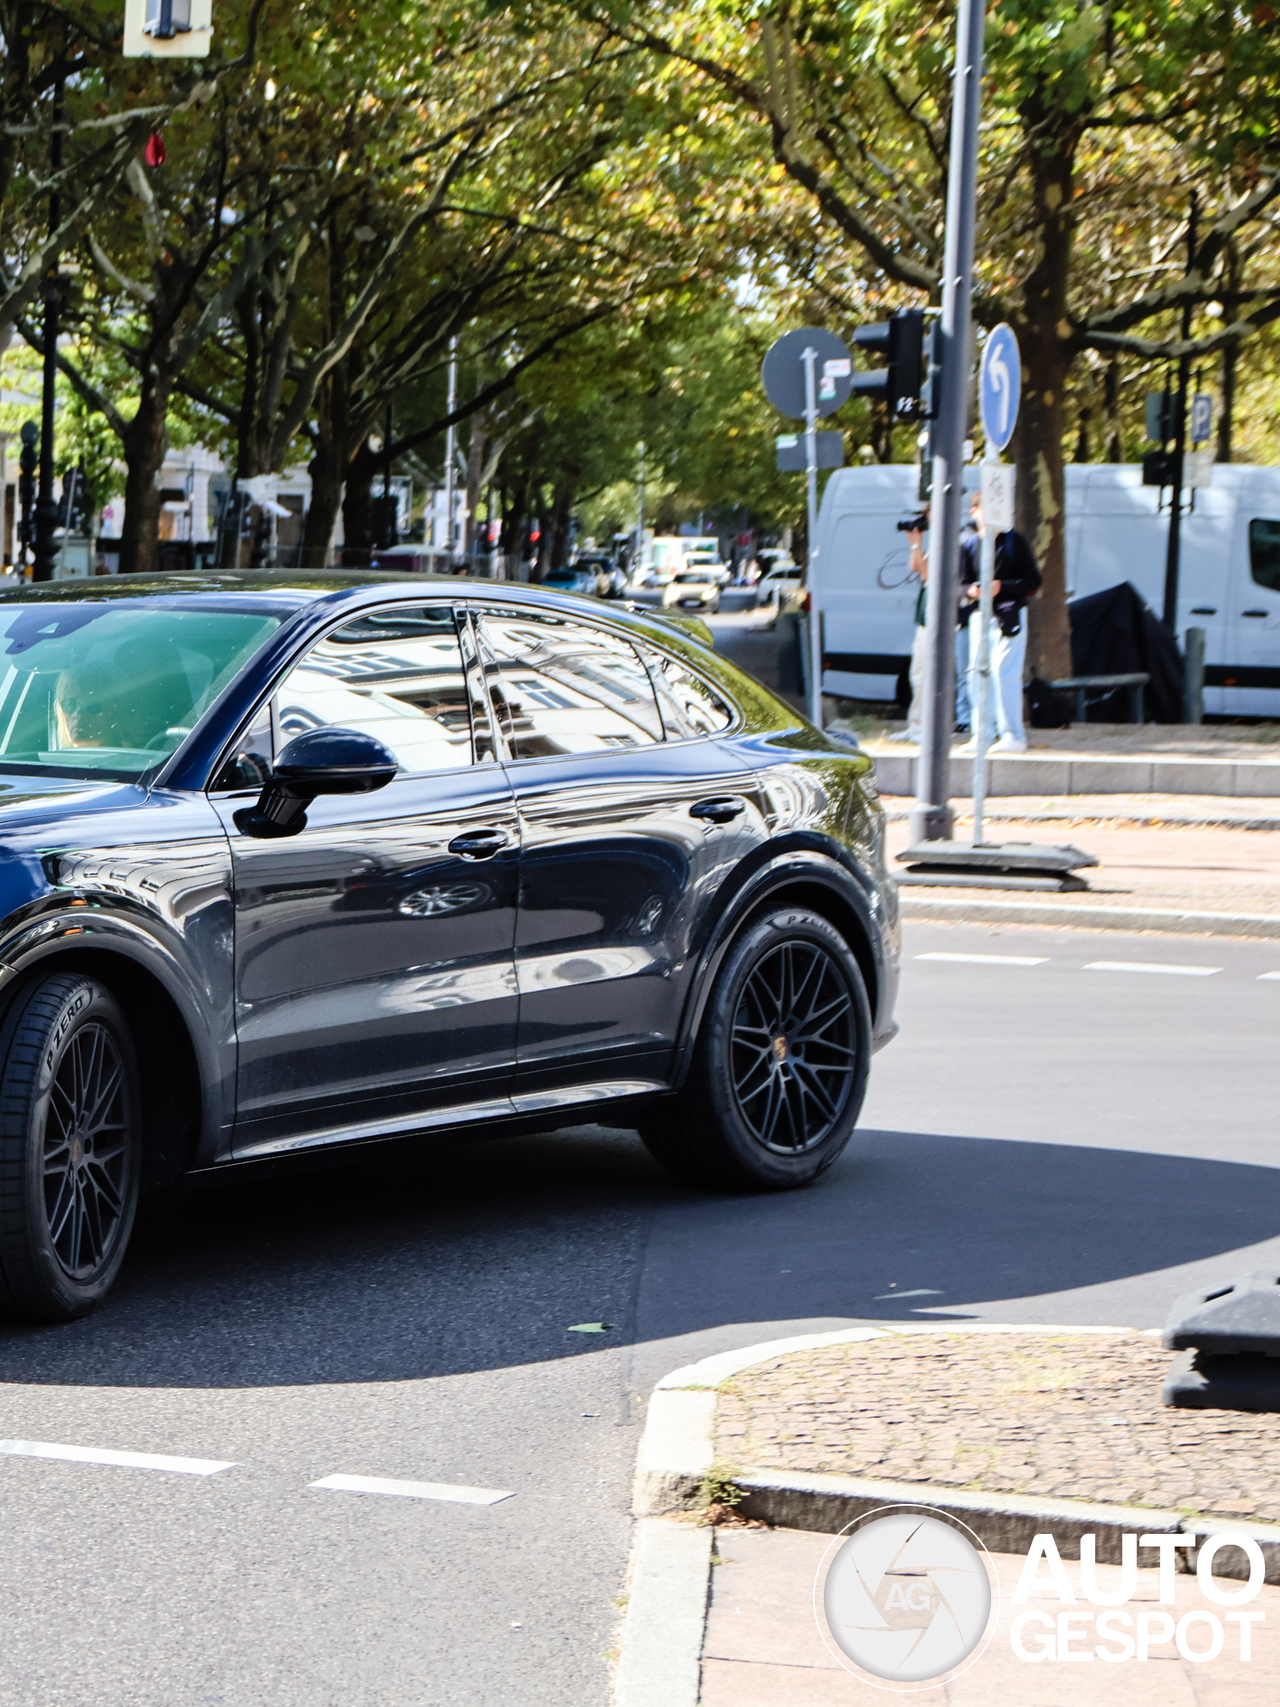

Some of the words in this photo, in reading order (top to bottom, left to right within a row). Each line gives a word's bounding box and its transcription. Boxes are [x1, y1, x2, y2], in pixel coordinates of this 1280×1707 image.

[1192, 399, 1210, 438] P
[46, 1049, 54, 1073] P
[53, 996, 83, 1050] ZERO
